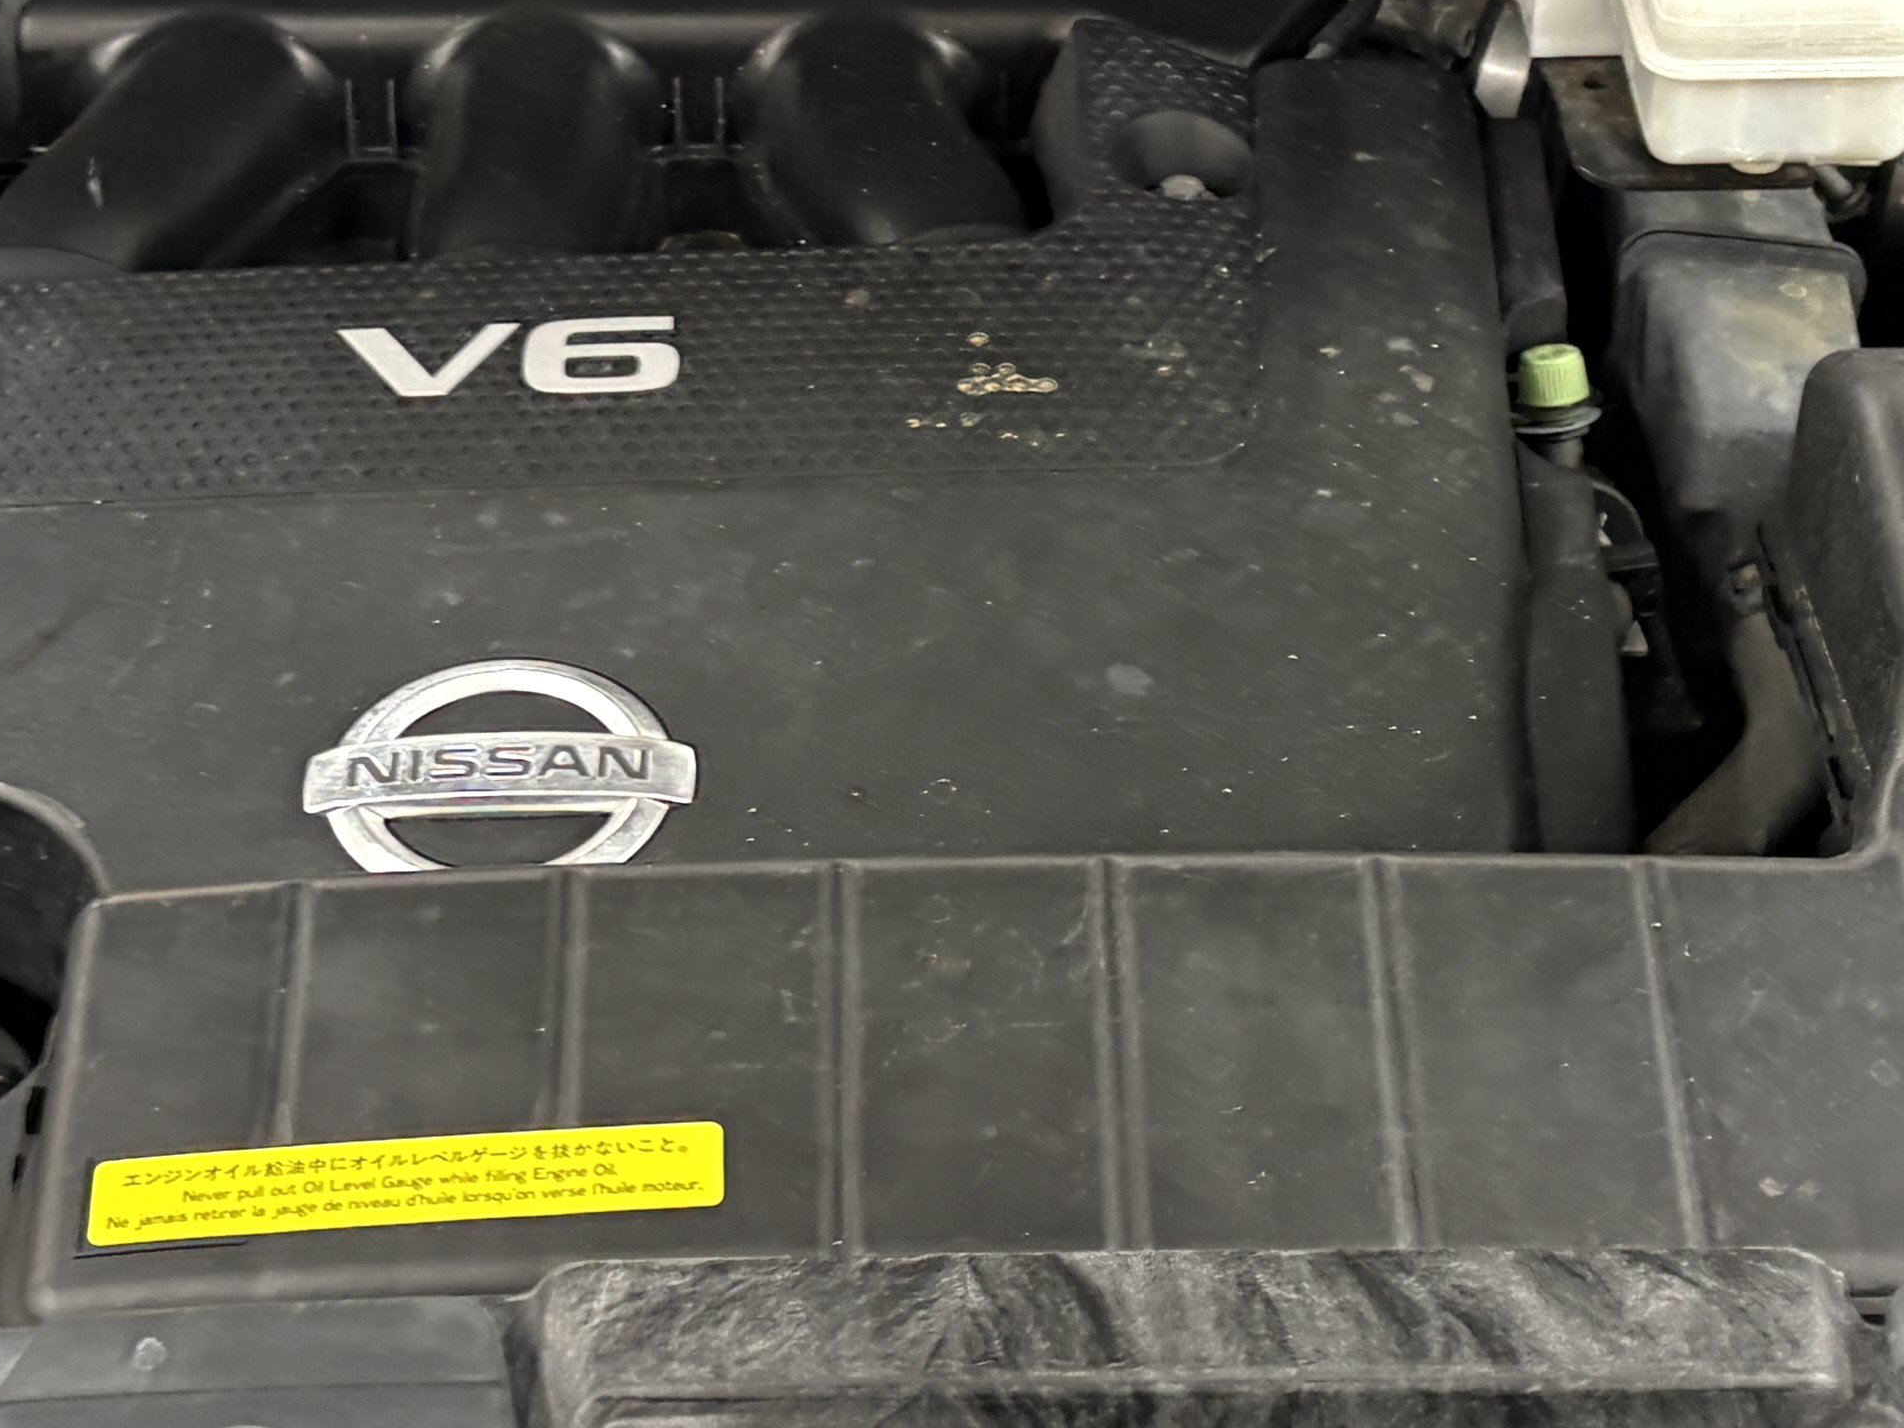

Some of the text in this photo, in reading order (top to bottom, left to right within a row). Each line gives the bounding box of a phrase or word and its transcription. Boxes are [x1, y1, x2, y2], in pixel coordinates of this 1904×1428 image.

[335, 315, 681, 397] V6
[345, 743, 653, 789] NISSAN
[106, 1216, 130, 1230] Ne
[134, 1211, 188, 1232] jamais
[193, 1207, 247, 1222] retirer
[252, 1205, 266, 1218] la
[270, 1203, 318, 1220] jauge
[322, 1199, 343, 1212] de
[347, 1197, 401, 1210] niveau
[541, 1186, 587, 1200] verse
[641, 1180, 704, 1194] moteur.
[182, 1162, 618, 1203] Never pull out Oil Level Gauge while filling Engine Oil
